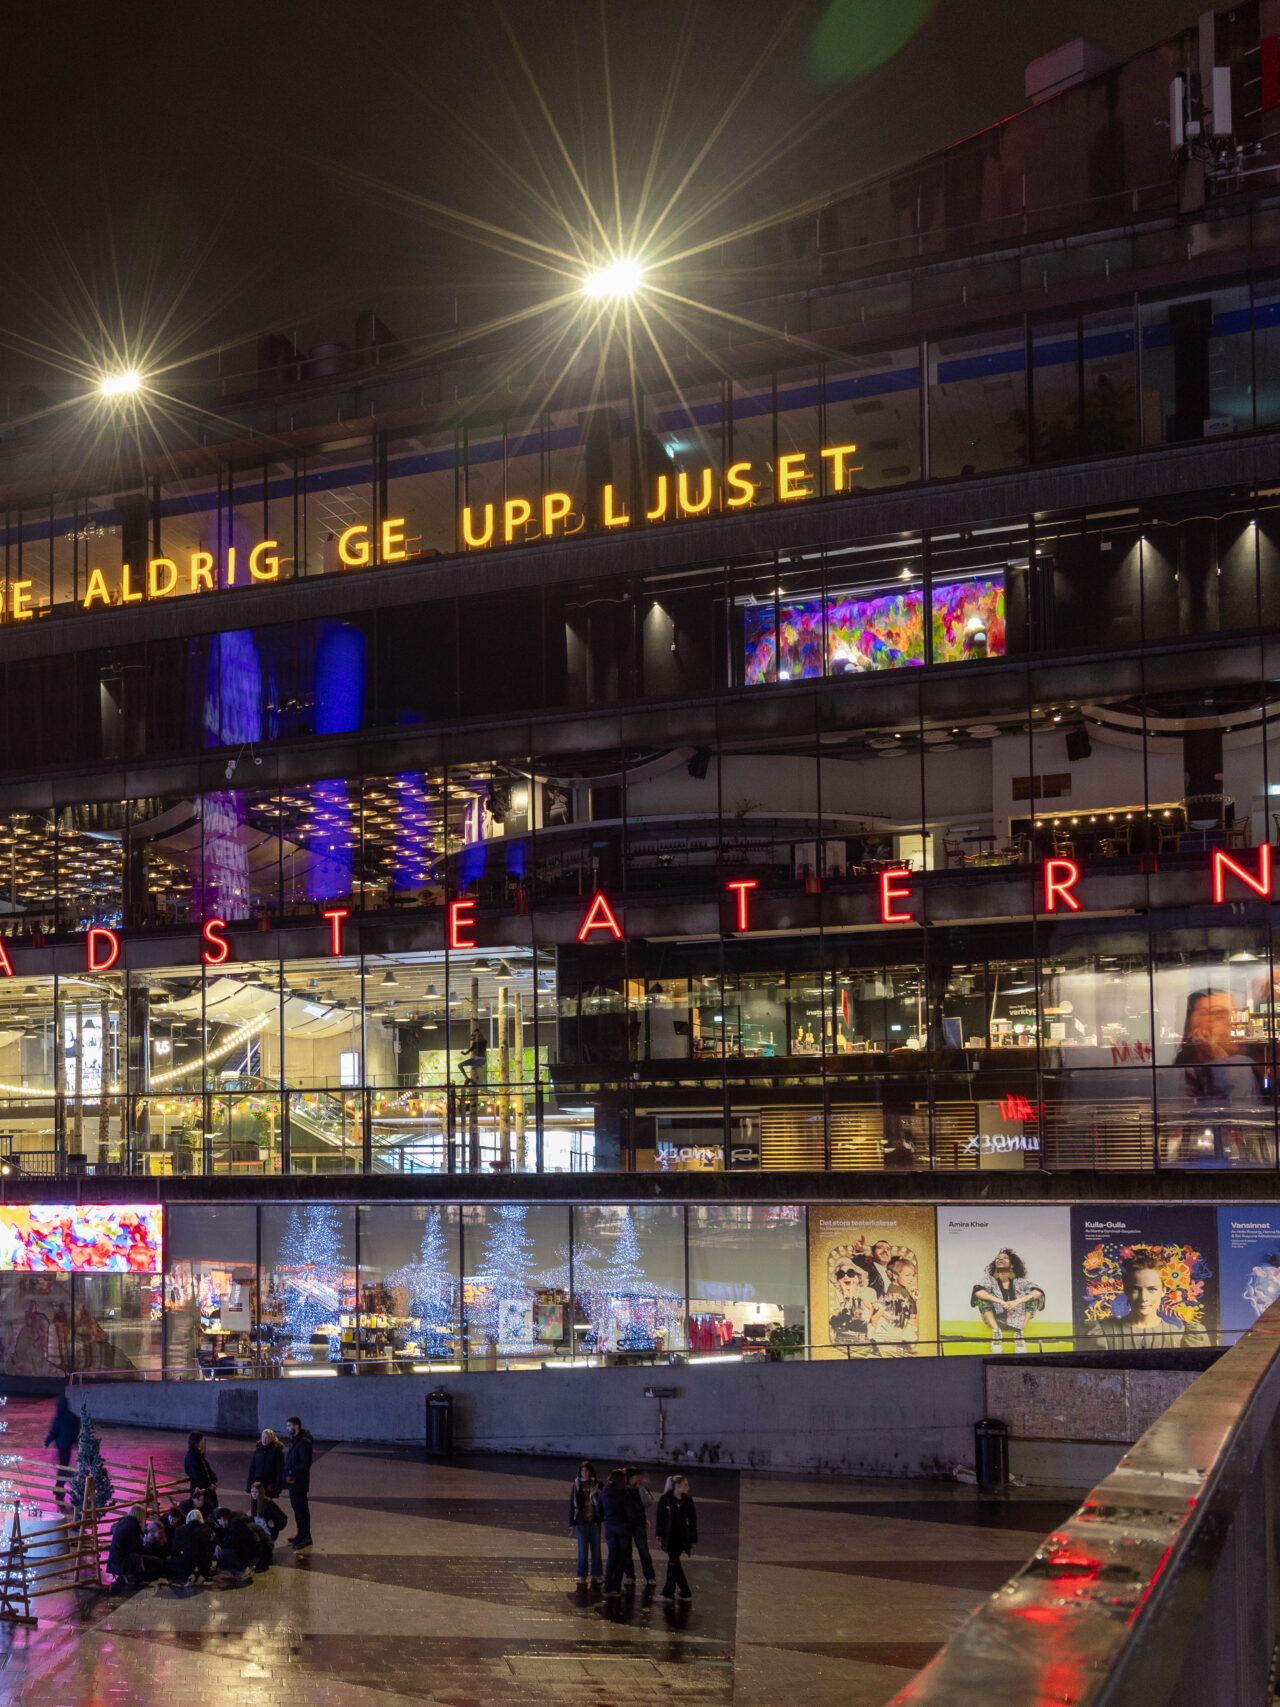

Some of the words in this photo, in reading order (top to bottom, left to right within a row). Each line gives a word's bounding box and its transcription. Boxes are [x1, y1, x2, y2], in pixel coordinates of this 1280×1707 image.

[82, 541, 280, 608] ALDRIG
[337, 518, 407, 567] GE
[462, 492, 572, 546] UPP
[603, 445, 856, 527] LJUSET
[1231, 1221, 1271, 1229] Vansinnet
